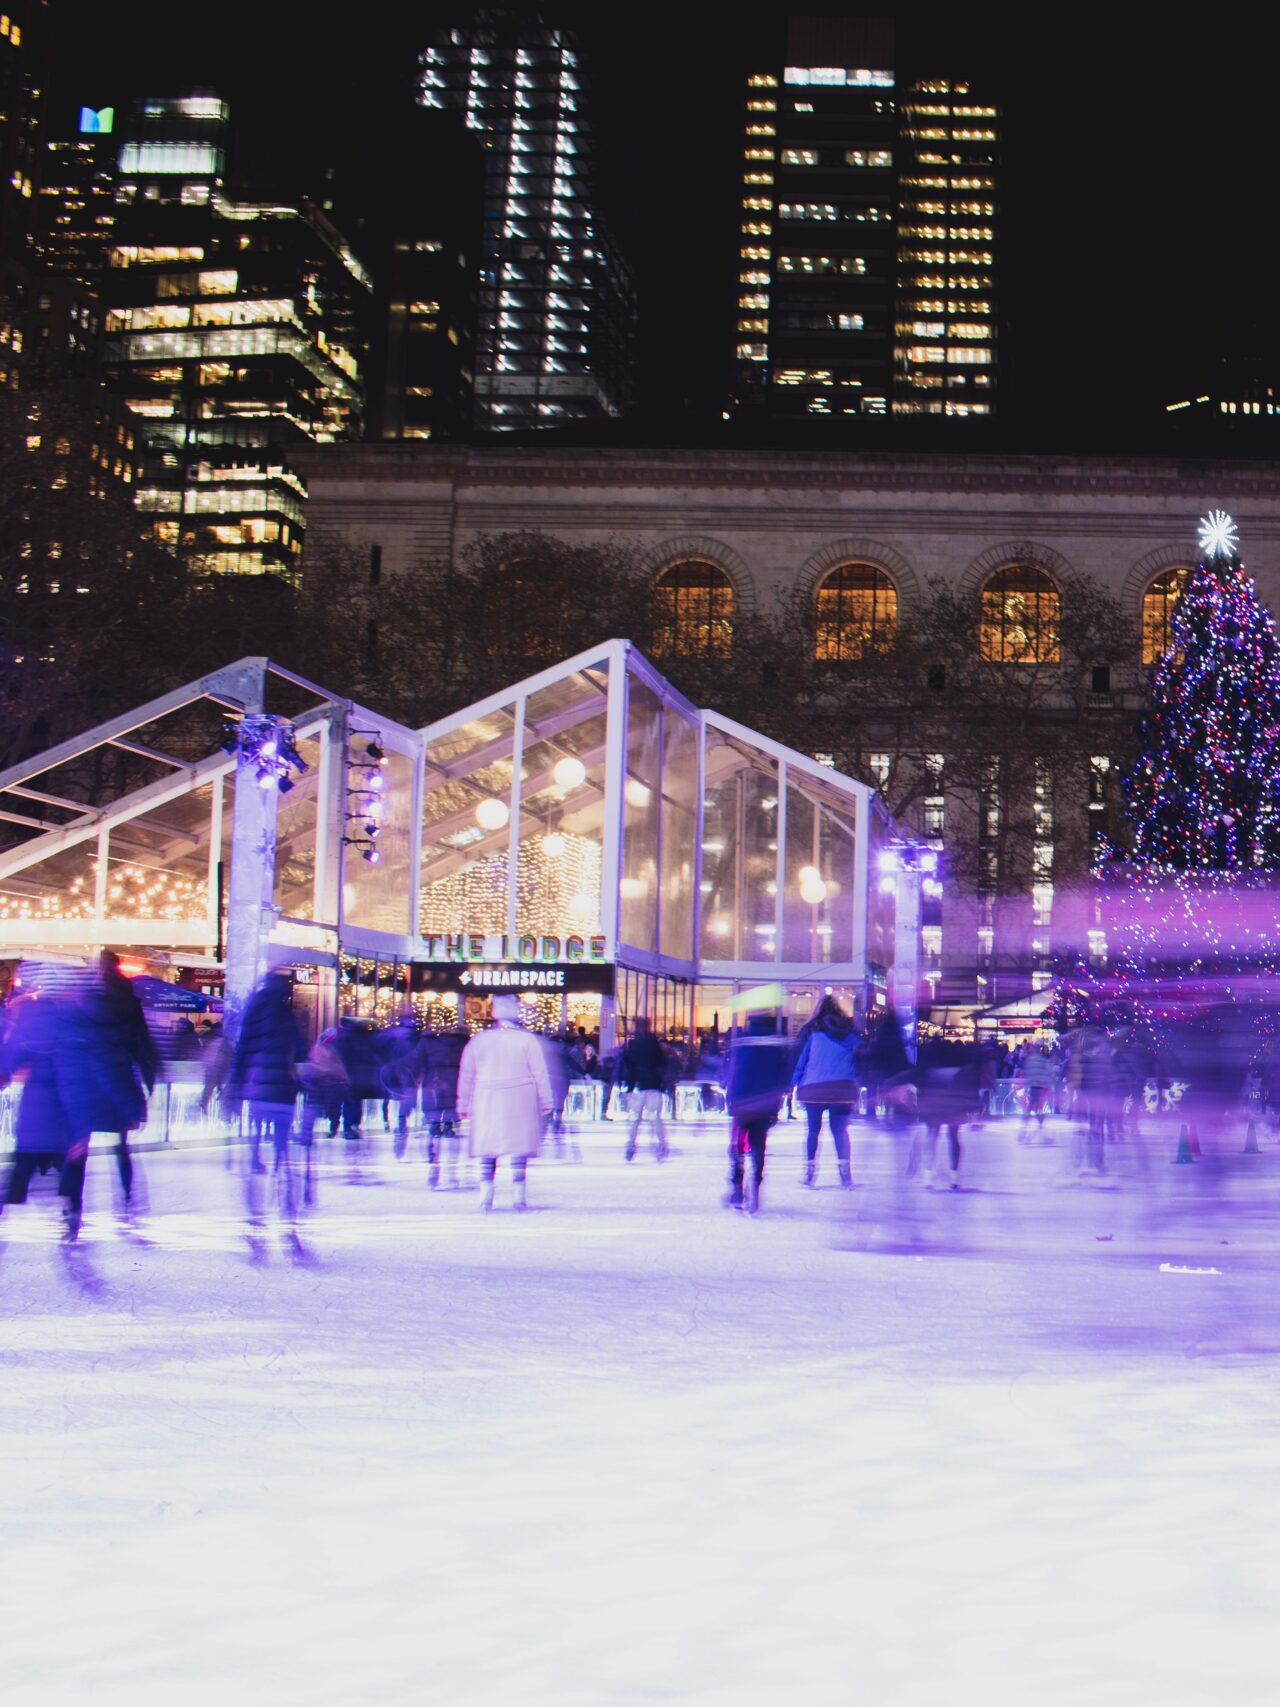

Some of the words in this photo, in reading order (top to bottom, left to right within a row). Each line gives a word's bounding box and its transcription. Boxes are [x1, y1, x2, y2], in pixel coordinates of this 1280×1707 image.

[421, 934, 485, 963] THE
[501, 934, 607, 963] LODGE
[472, 970, 565, 987] URBANSPACE
